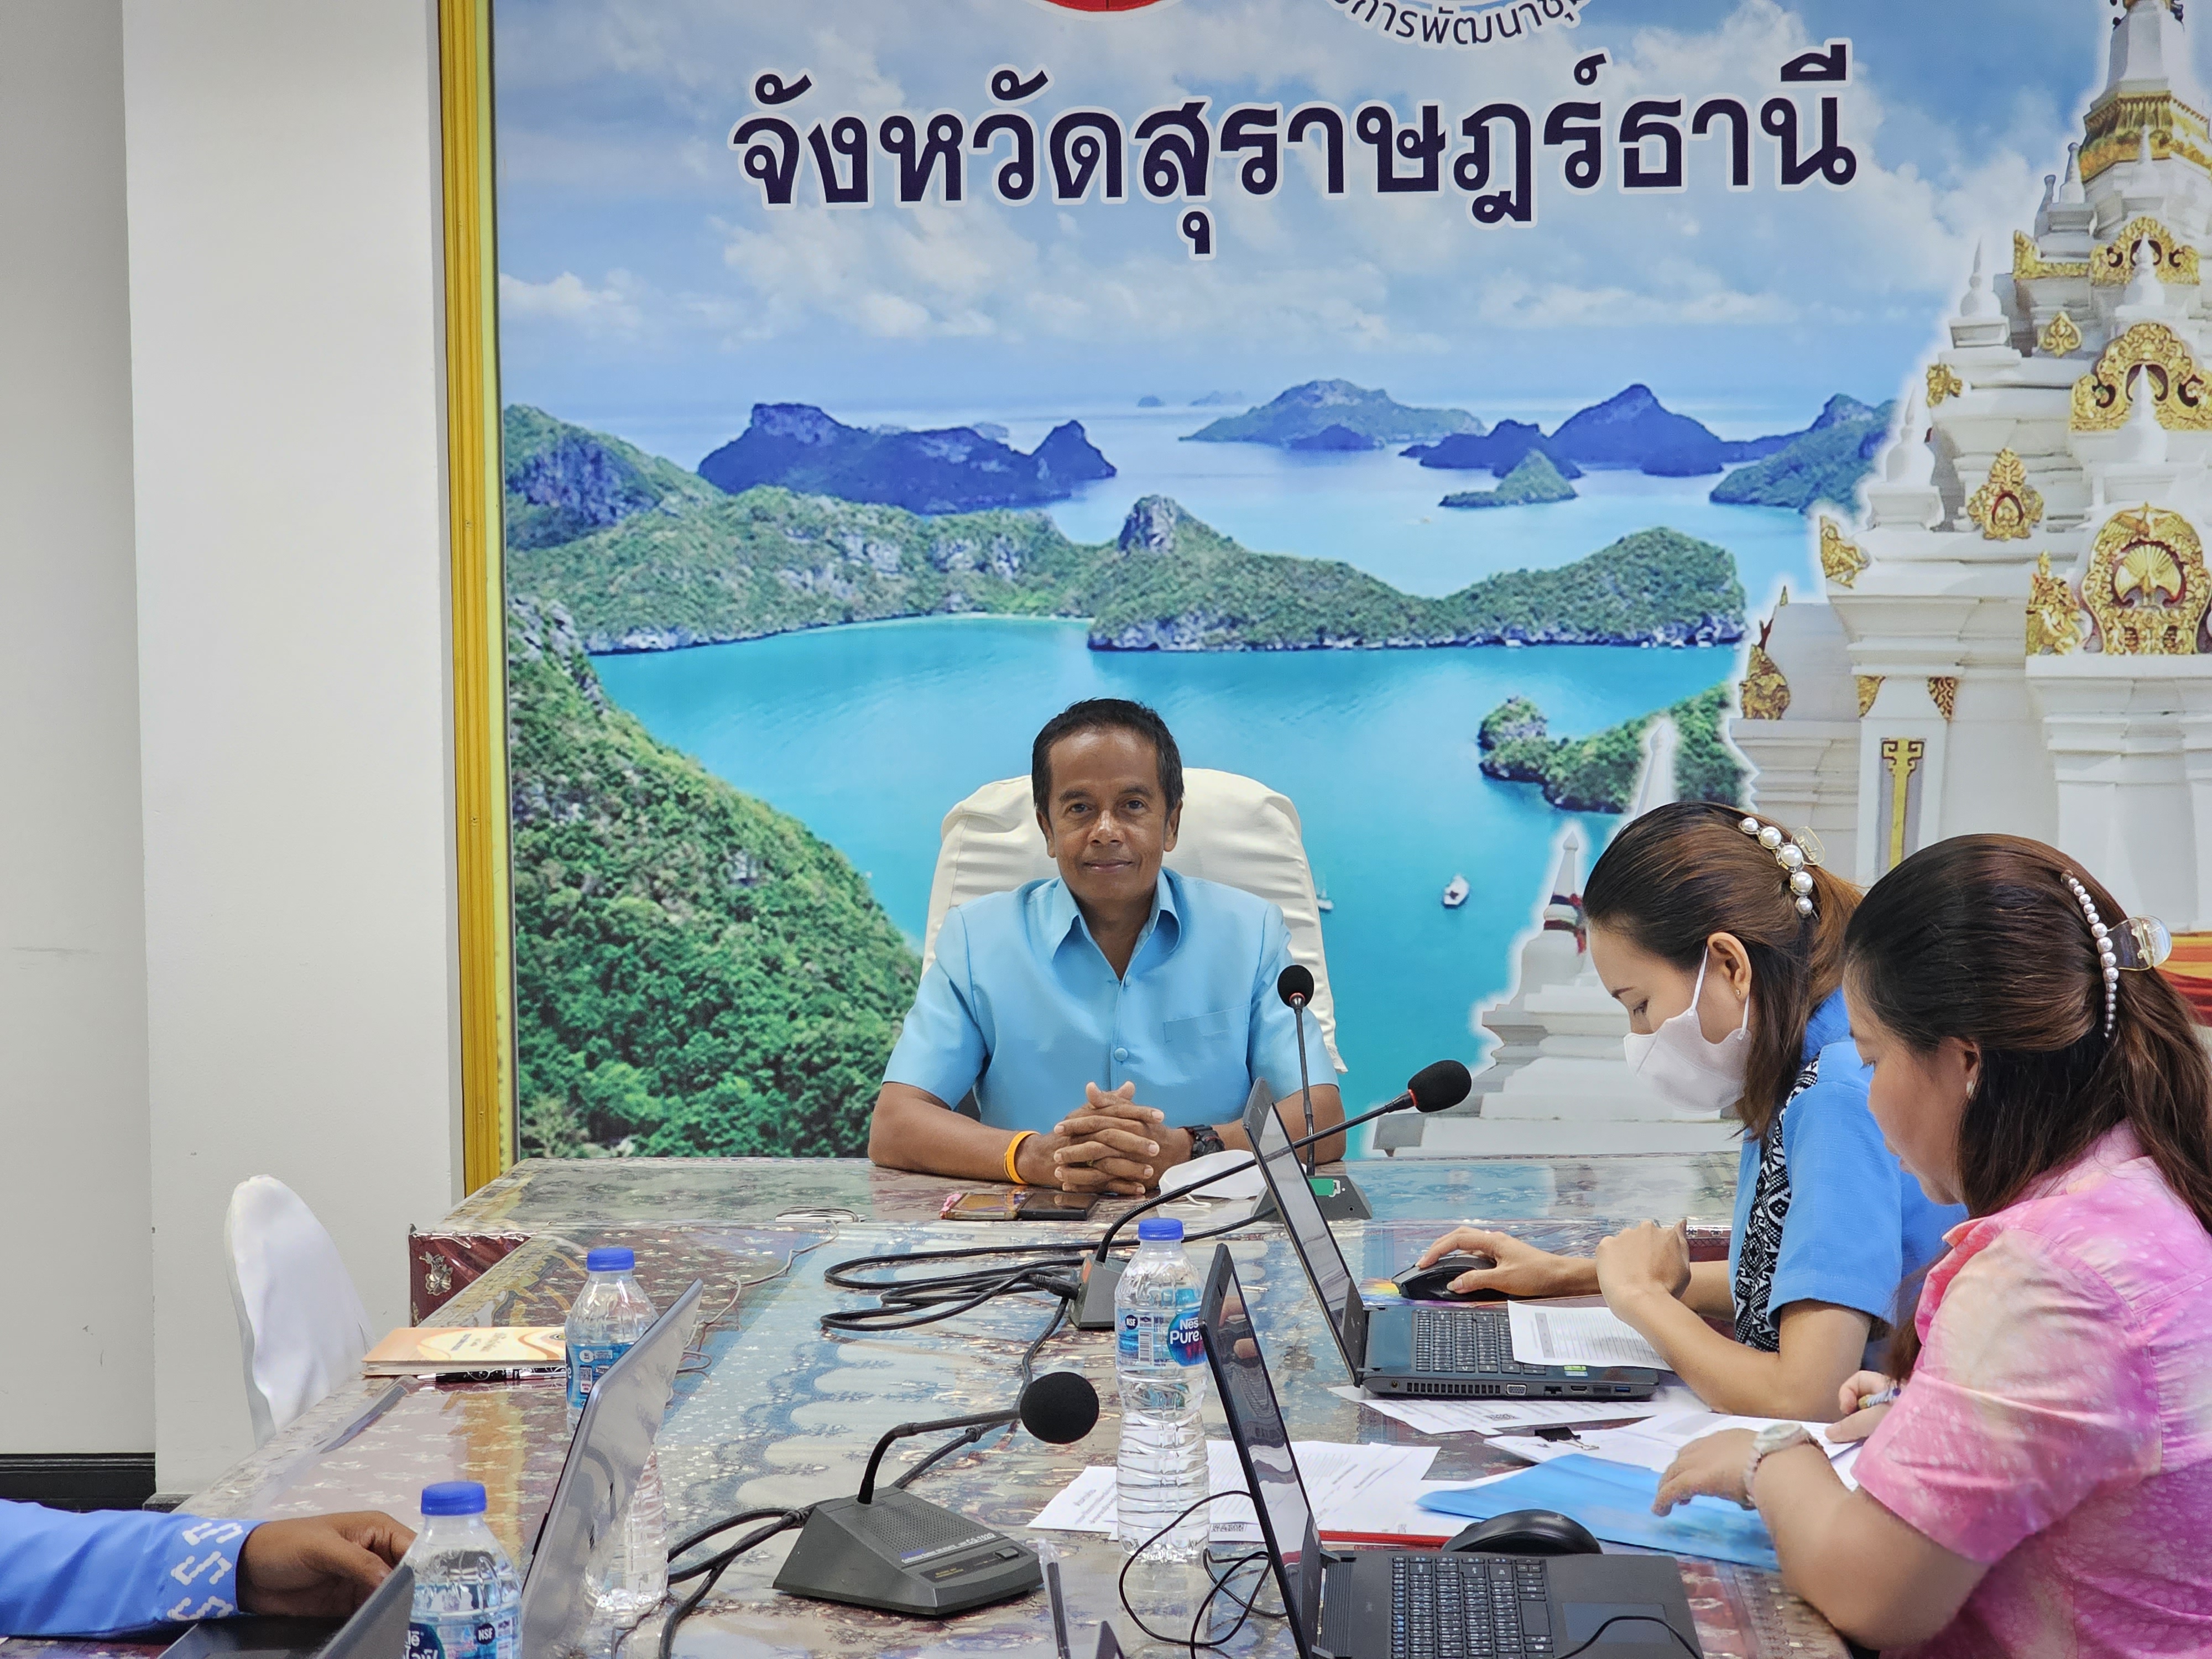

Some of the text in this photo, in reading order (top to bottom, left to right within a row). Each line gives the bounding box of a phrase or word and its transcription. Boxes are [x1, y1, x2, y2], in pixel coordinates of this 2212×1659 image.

[1334, 0, 1579, 44] การพัฒนาชุ
[734, 44, 1856, 254] จังหวัดสุราษฎร์ธานี
[1180, 1317, 1199, 1331] Nes
[478, 1627, 493, 1641] NSF
